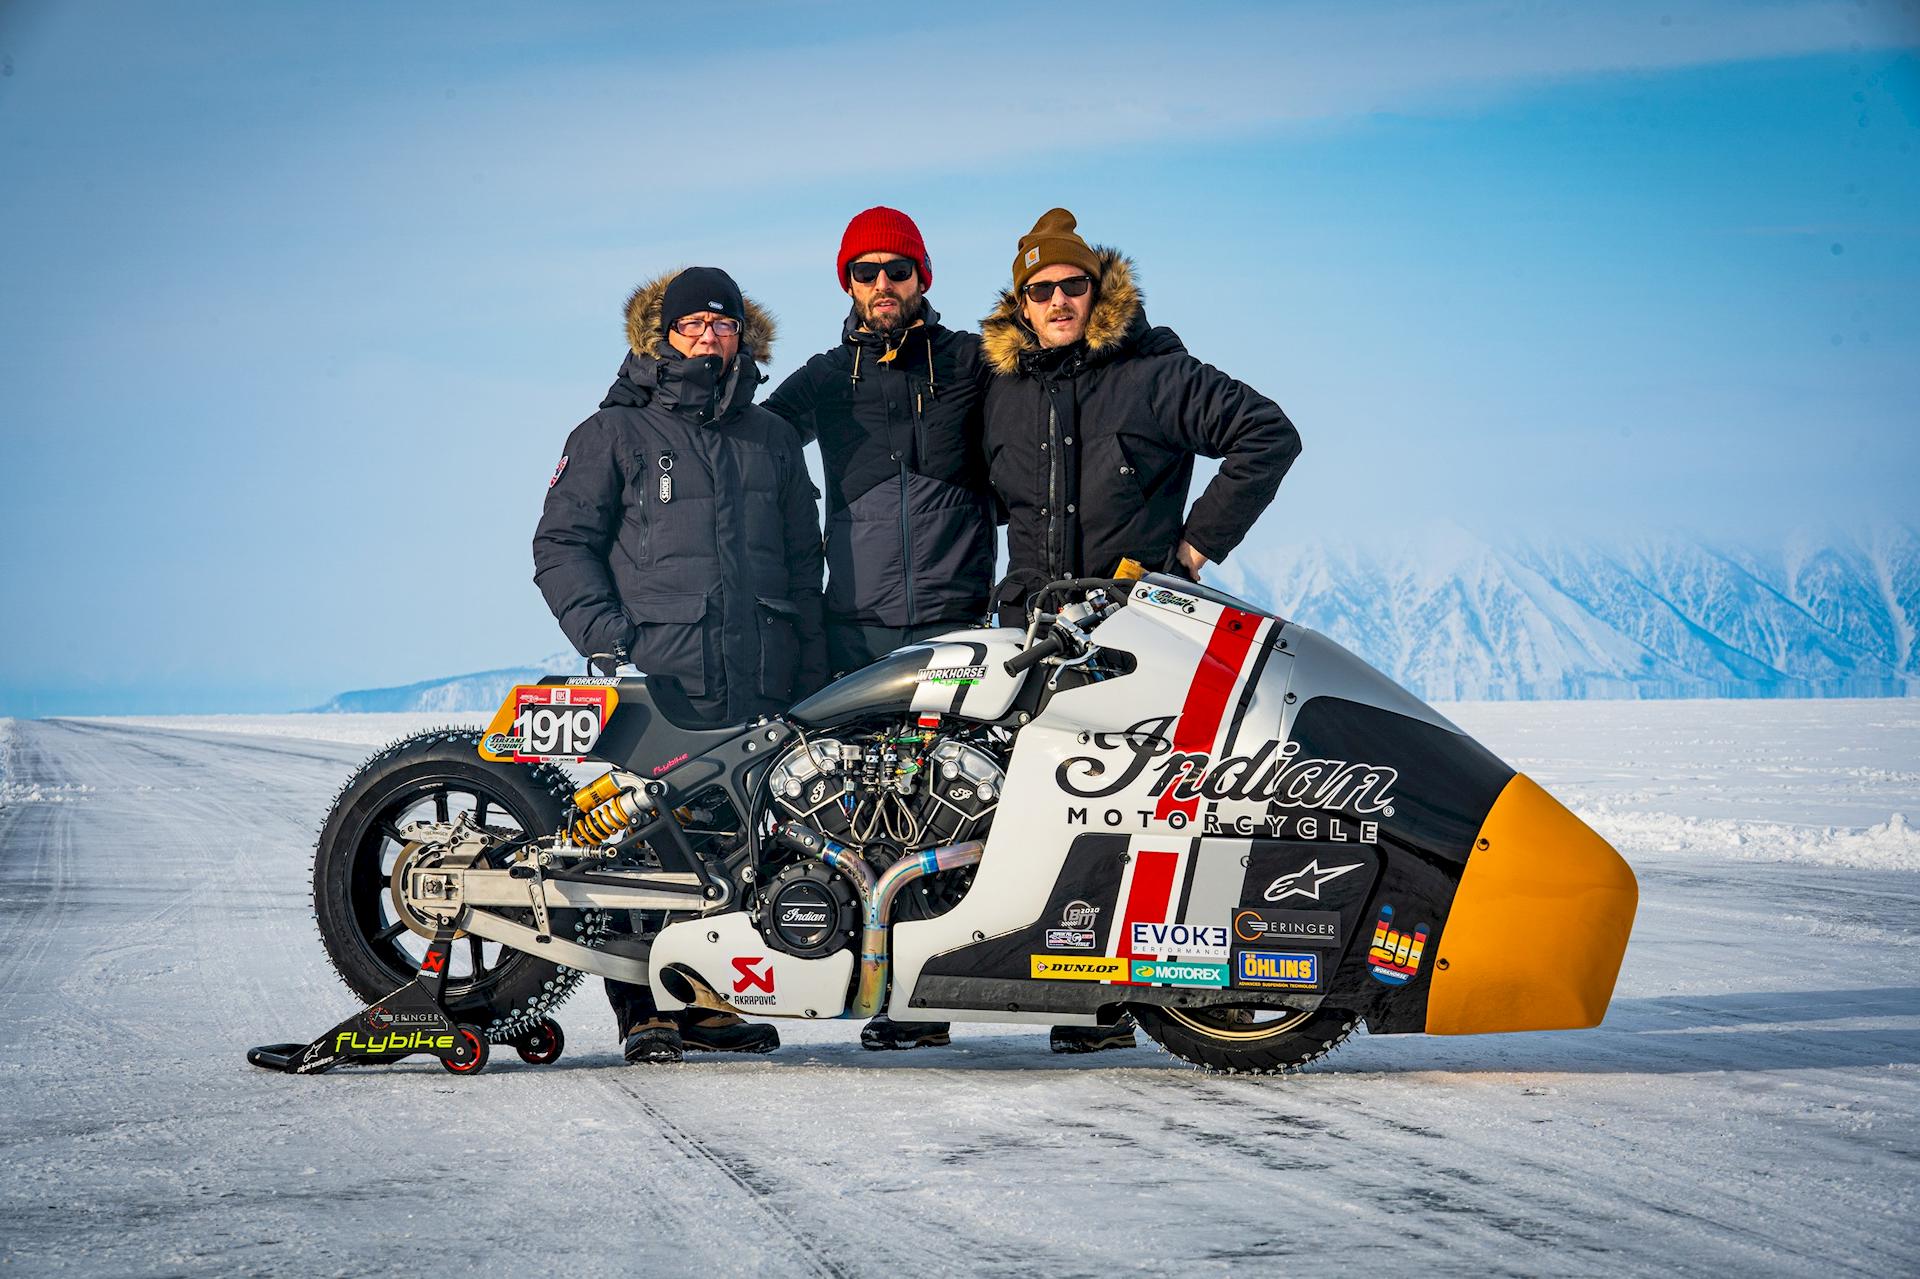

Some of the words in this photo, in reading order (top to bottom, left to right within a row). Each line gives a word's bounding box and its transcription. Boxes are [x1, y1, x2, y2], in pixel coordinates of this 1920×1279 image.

[917, 667, 986, 682] WORKHORSE
[567, 677, 616, 687] WORKHORSE
[514, 708, 599, 754] 1919
[1055, 714, 1399, 814] Indian
[1067, 806, 1379, 844] MOTORCYCLE
[782, 908, 826, 922] Indian
[1248, 921, 1335, 934] BERINGER
[1133, 946, 1227, 956] PERFORMANCE
[1051, 963, 1119, 973] DUNLOP
[1244, 953, 1312, 978] ÖHLINS
[1155, 966, 1221, 981] MOTOREX
[379, 1013, 440, 1022] BERINGER
